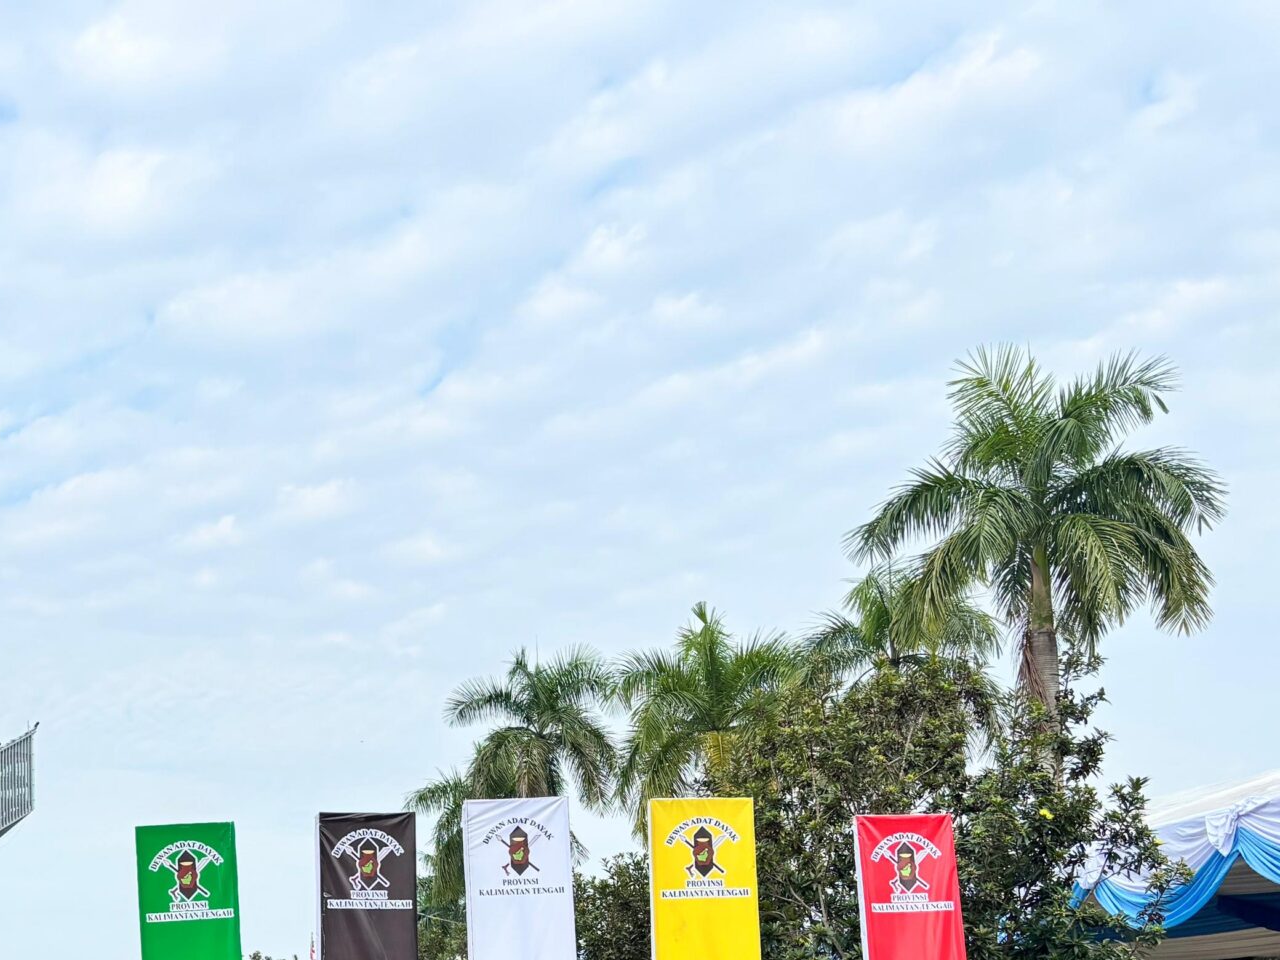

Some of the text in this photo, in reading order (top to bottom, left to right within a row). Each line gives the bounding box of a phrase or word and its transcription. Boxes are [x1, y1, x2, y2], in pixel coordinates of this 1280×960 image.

[482, 817, 554, 845] DEWAN ADAT DAYAK
[666, 817, 737, 845] DEWAN ADAT DAYAK
[333, 832, 357, 856] DEWAN
[379, 832, 403, 854] DAYAK
[872, 836, 894, 860] DEWAN
[916, 837, 939, 857] DAYAK
[150, 842, 221, 870] DEWAN ADAT DAYAK
[502, 878, 539, 886] PROVINSI
[686, 880, 723, 888] PROVINSI
[479, 886, 565, 896] KALIMANTAN TENGAH
[662, 888, 749, 898] KALIMANTAN TENGAH
[171, 902, 207, 910] PROVINSI
[379, 900, 411, 908] TENGAH
[922, 902, 952, 910] TENGAH
[148, 910, 232, 921] KALIMANTAN TENGAH
